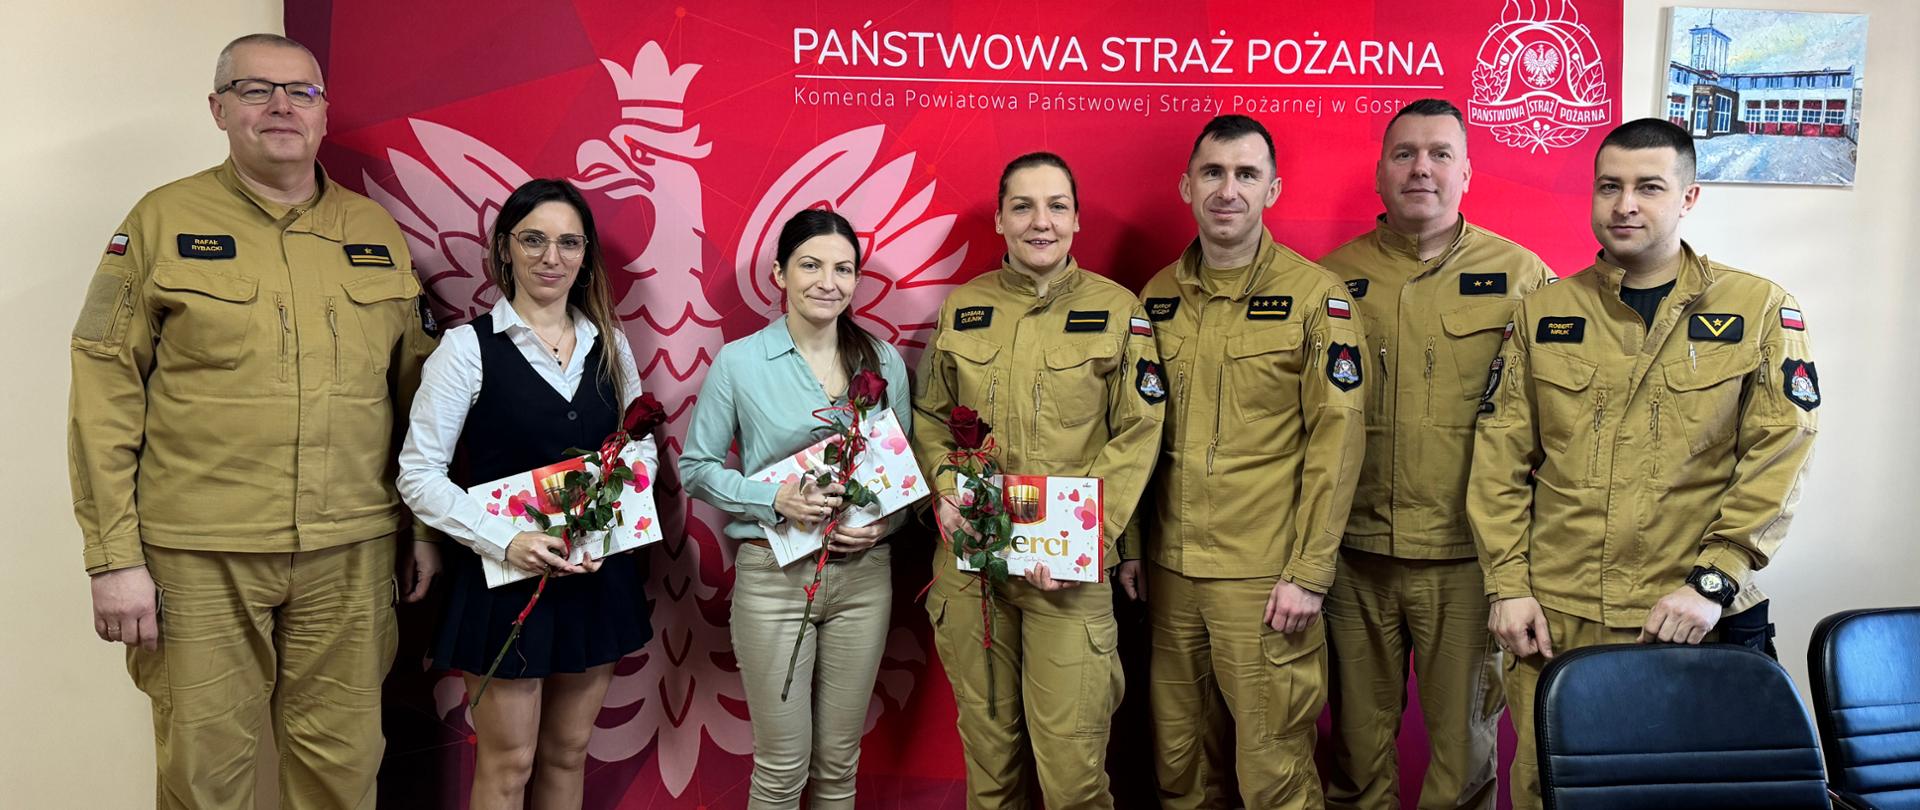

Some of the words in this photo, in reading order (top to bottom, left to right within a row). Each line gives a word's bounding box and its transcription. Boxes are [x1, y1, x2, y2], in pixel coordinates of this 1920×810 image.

[793, 20, 1088, 72] PAŃSTWOWA
[1101, 29, 1234, 74] STRAŻ
[1247, 31, 1444, 76] POŻARNA
[794, 87, 895, 107] Komenda
[905, 89, 1018, 110] Powiatowa
[1028, 92, 1150, 117] Państwowej
[1160, 94, 1223, 117] Straży
[1233, 95, 1322, 118] Pożarnej
[1332, 100, 1346, 113] w
[1471, 104, 1525, 122] PAŃSTWOWA
[1528, 99, 1555, 114] STRAŻ
[1560, 107, 1606, 123] POŻARNA
[1004, 530, 1069, 557] erci
